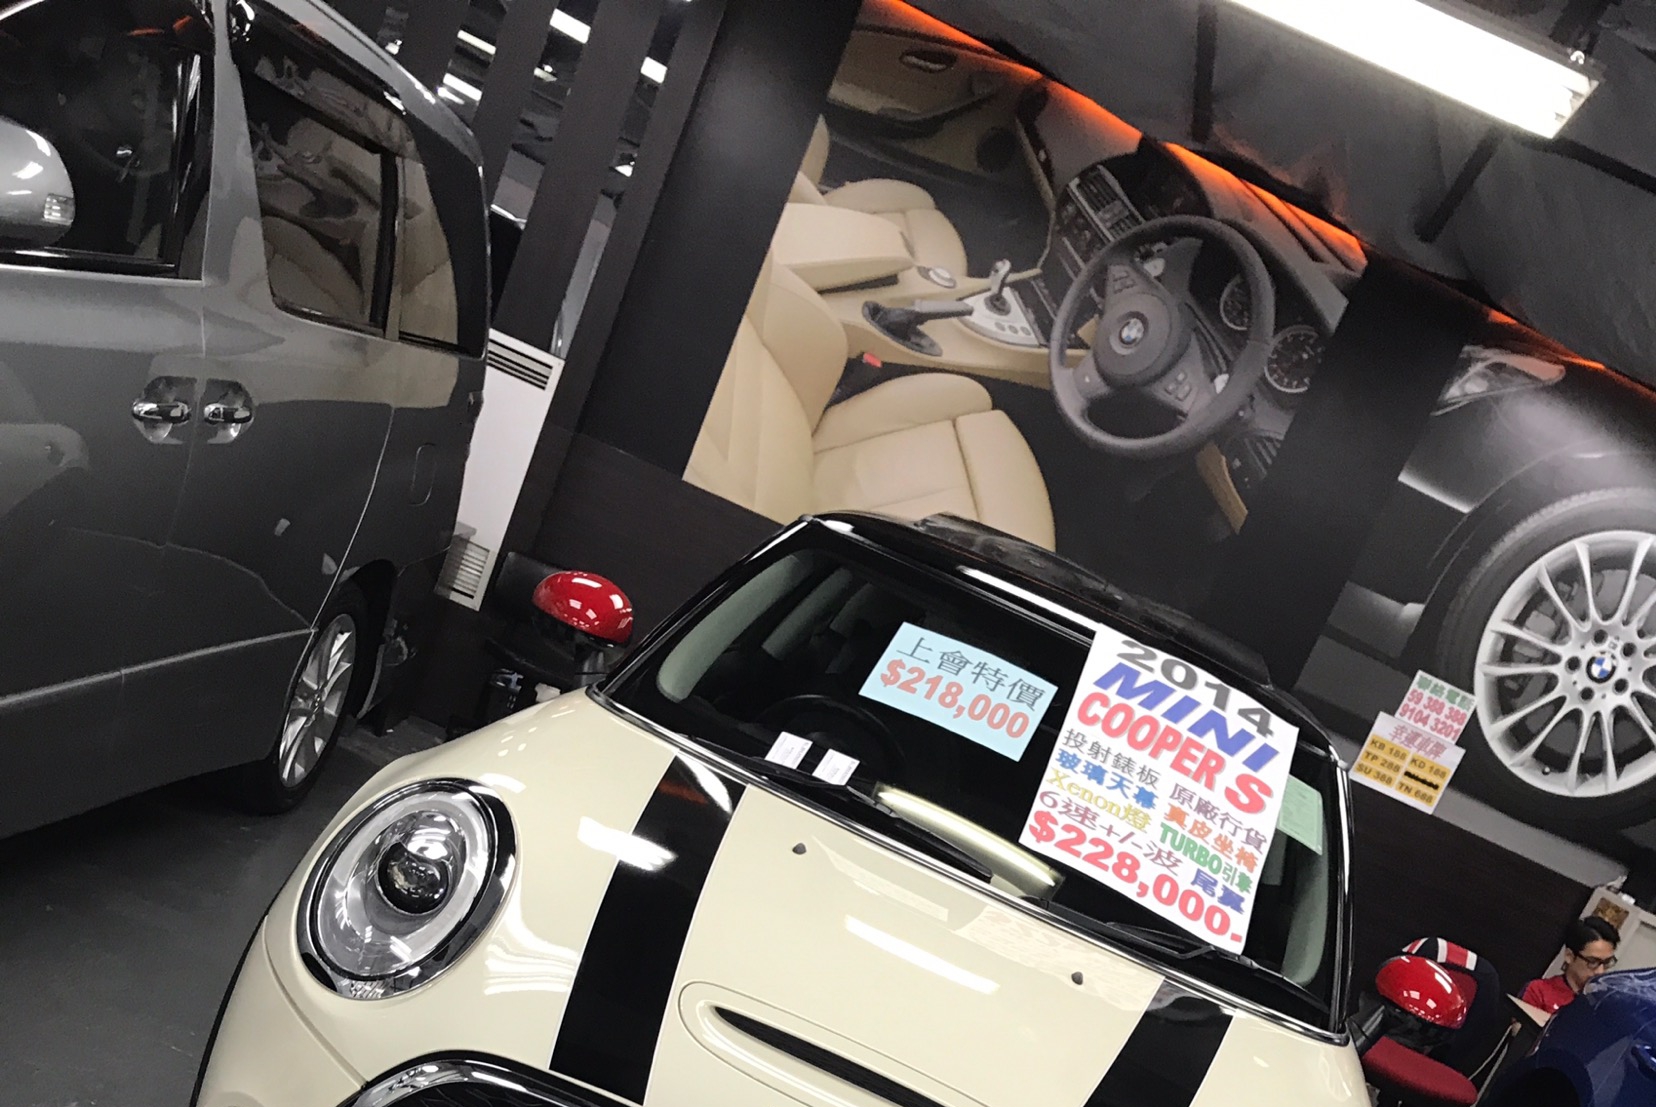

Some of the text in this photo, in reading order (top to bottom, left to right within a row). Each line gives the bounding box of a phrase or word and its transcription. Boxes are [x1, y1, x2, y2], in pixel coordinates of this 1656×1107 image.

[880, 658, 1030, 739] $218,000
[1116, 639, 1274, 738] 2014
[1407, 688, 1424, 705] 59
[1093, 662, 1280, 773] MINI
[1399, 703, 1462, 741] 9104 3201
[1077, 692, 1274, 814] COOPER S
[1364, 751, 1379, 762] TP
[1410, 757, 1426, 769] KD
[1357, 763, 1372, 775] SU
[1398, 782, 1412, 793] TN
